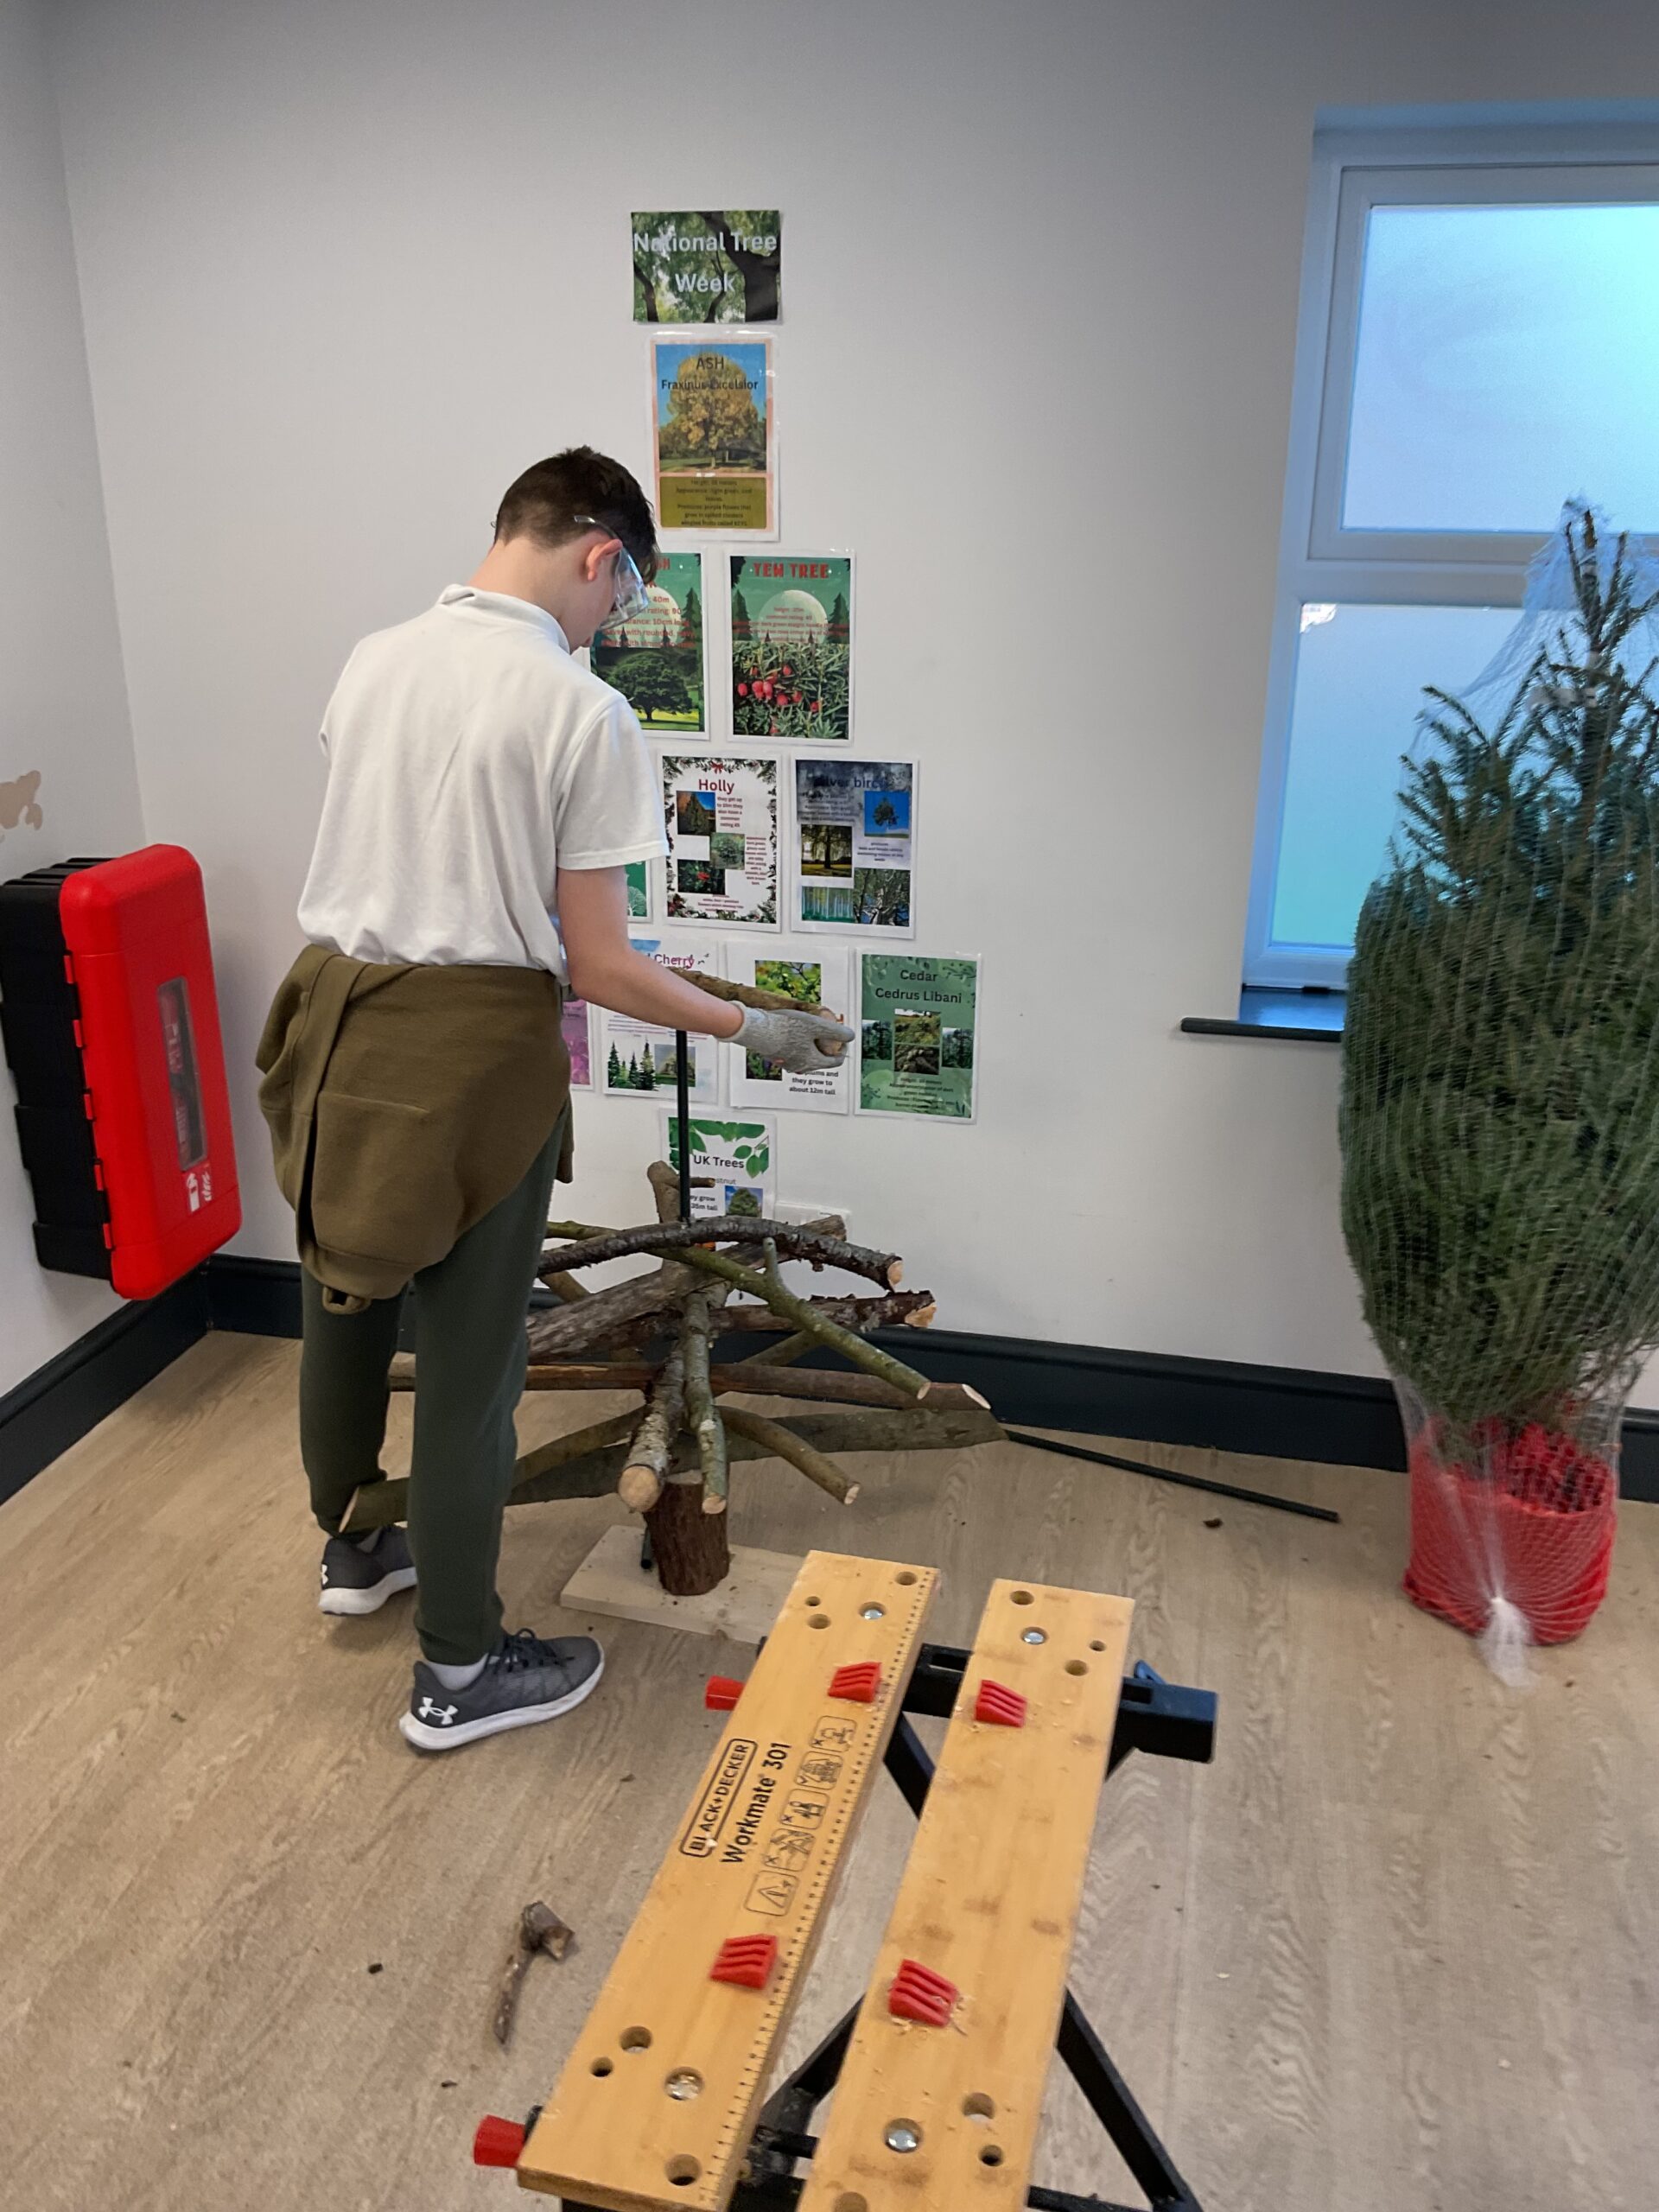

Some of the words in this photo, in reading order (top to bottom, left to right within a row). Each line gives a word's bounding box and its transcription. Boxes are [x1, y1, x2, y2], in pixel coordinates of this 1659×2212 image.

[633, 232, 726, 252] National
[730, 230, 778, 251] Tree
[675, 273, 735, 293] Week
[696, 357, 725, 370] ASH
[789, 563, 830, 579] TREE
[698, 779, 735, 795] Holly
[654, 953, 695, 969] Cherry
[899, 969, 938, 982] Cedar
[874, 988, 920, 1001] Cedrus
[923, 991, 963, 1003] Libani
[693, 1154, 711, 1166] UK
[713, 1156, 745, 1169] Trees
[720, 1777, 777, 1864] Workmate
[761, 1742, 792, 1770] 301
